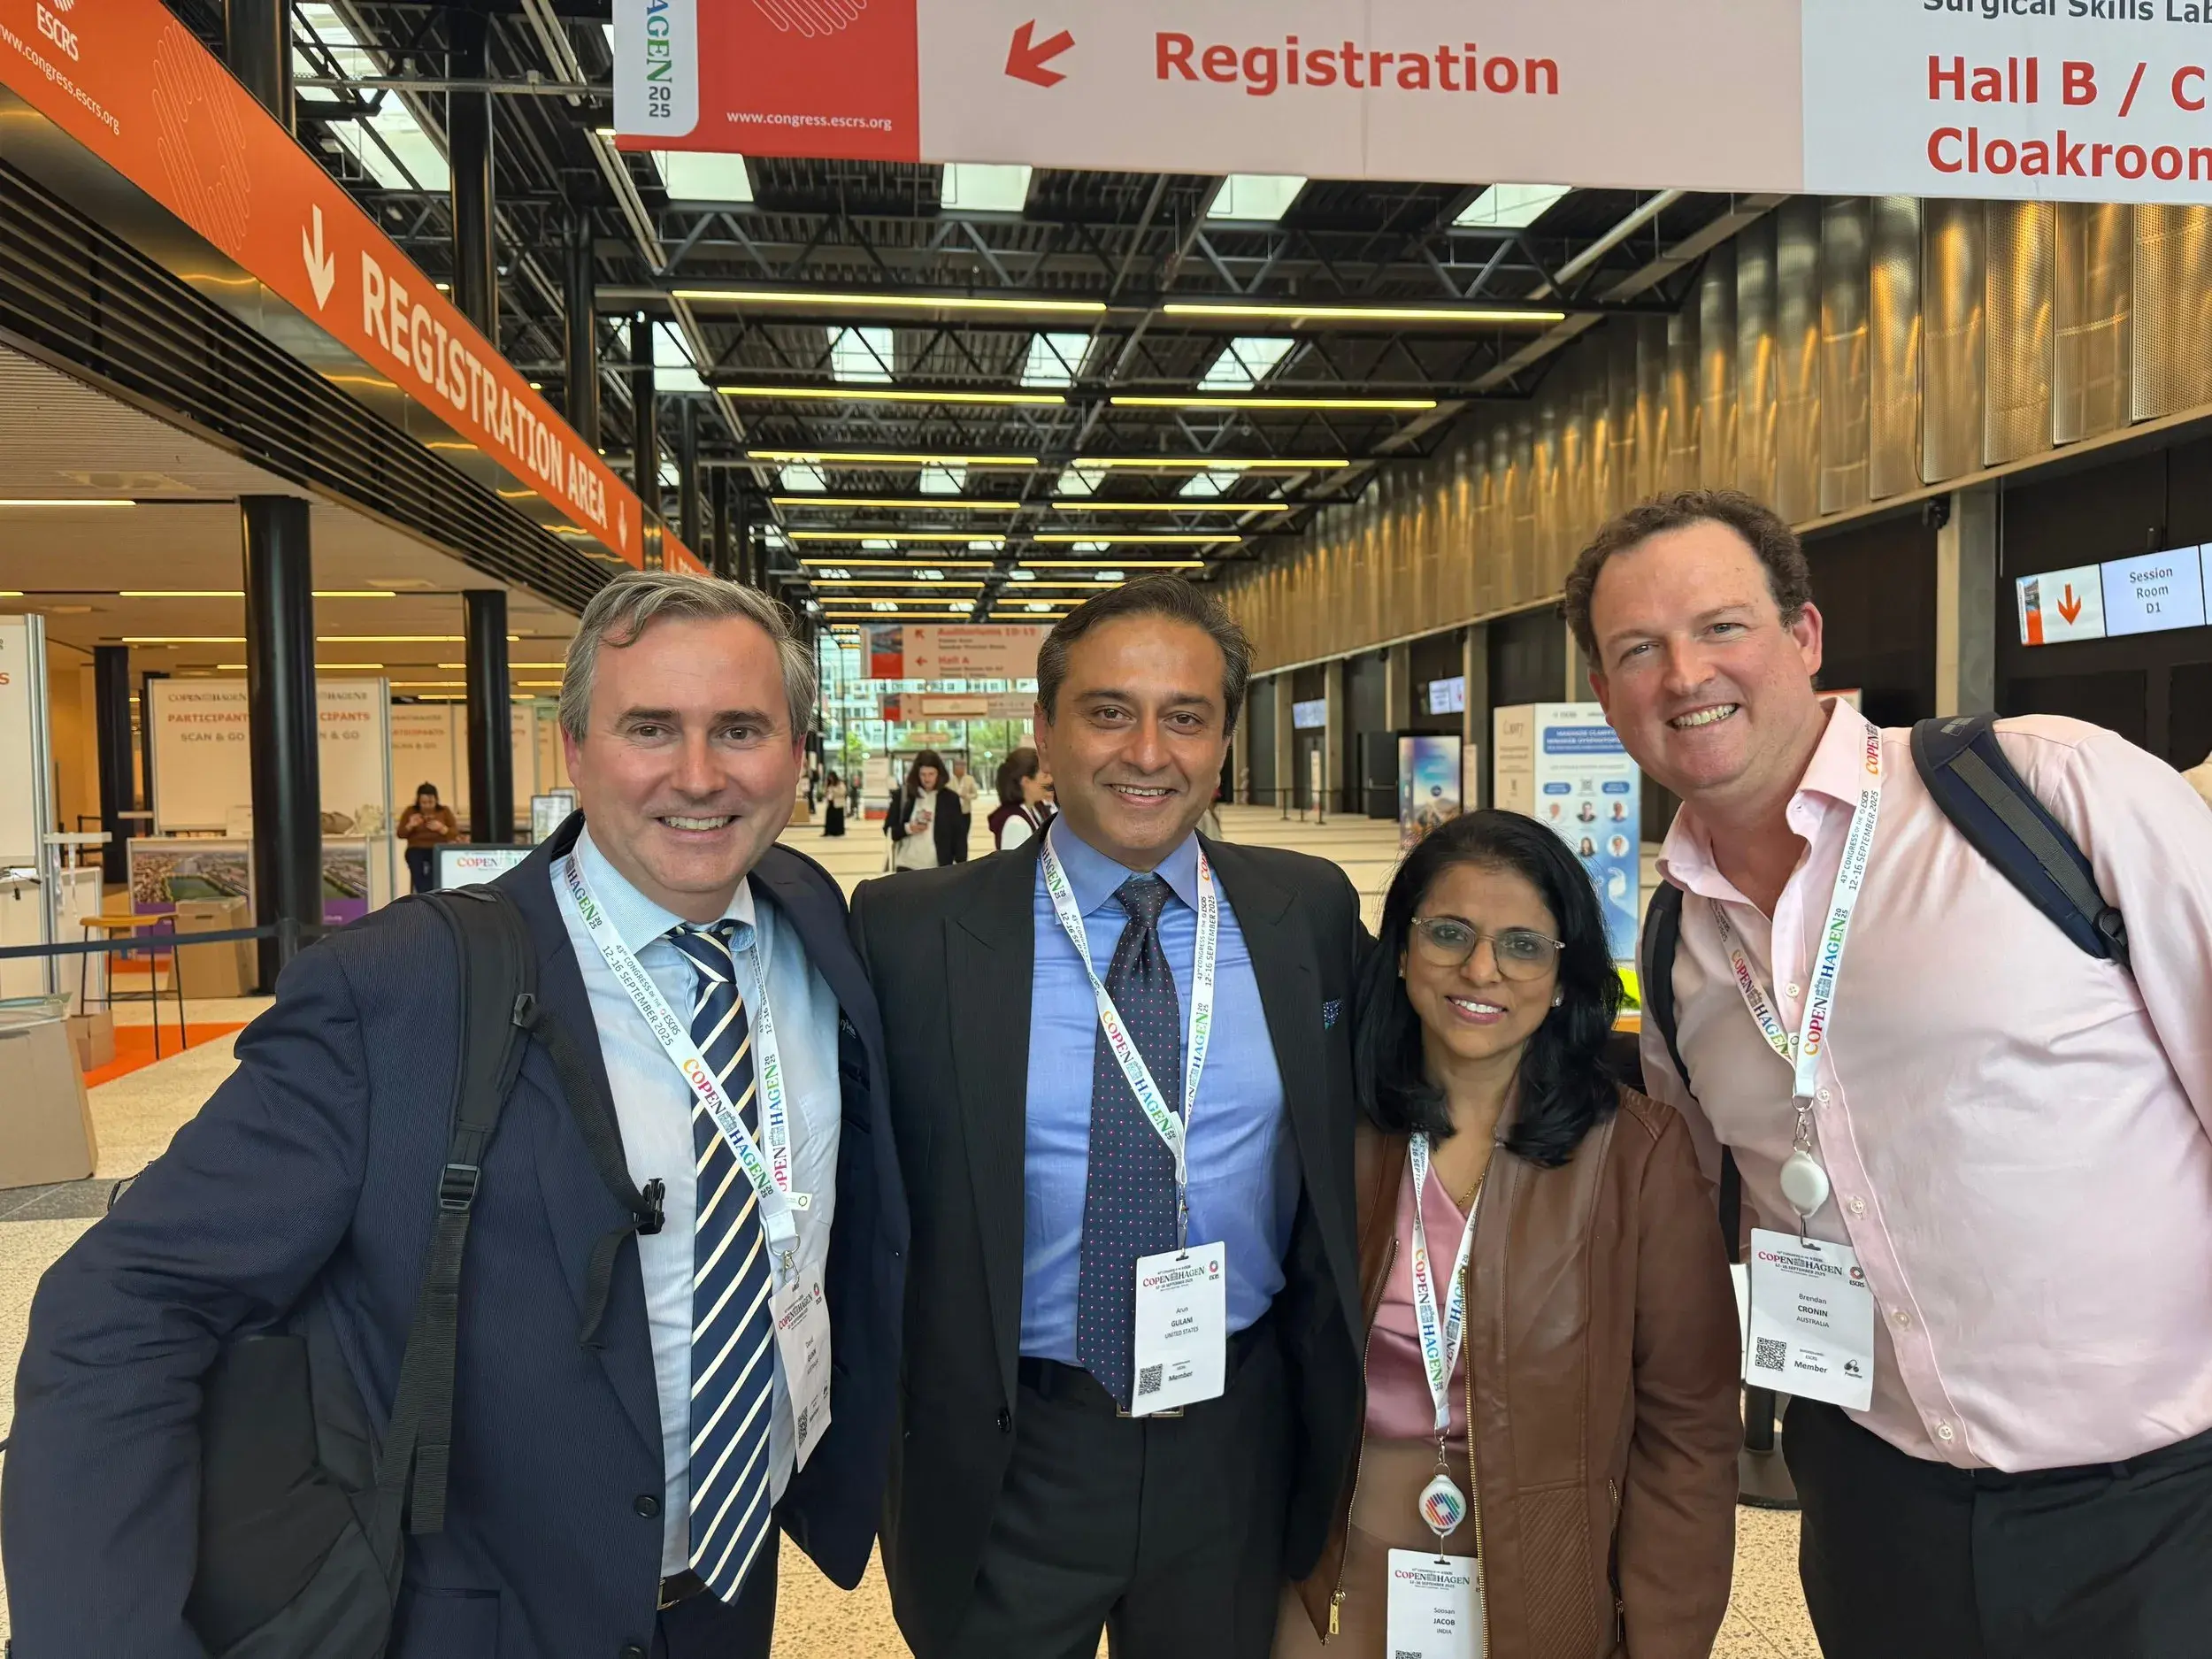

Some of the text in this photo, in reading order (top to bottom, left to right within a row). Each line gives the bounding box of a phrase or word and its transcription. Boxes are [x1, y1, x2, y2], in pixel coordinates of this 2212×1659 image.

[2068, 0, 2154, 20] Skills
[36, 2, 79, 62] ESCRS
[1156, 32, 1559, 96] Registration
[649, 86, 671, 101] 20
[1928, 55, 2205, 117] Hall B / C
[649, 104, 671, 118] 25
[726, 111, 892, 131] www.congress.escrs.org
[361, 250, 608, 531] REGISTRATION AREA
[2130, 566, 2173, 583] Session
[2136, 585, 2169, 599] Room
[2146, 603, 2162, 614] D1
[180, 733, 213, 741] SCAN
[227, 732, 245, 741] GO
[1865, 732, 1879, 779] COPEN
[1861, 812, 1876, 864] SEPTEMBER
[1870, 790, 1878, 812] 2025
[1845, 833, 1859, 870] CONGRESS
[566, 871, 598, 923] HAGEN
[595, 916, 603, 926] 20
[1834, 908, 1841, 917] 20
[1841, 909, 1848, 919] 25
[589, 920, 596, 930] 25
[1206, 914, 1217, 961] SEPTEMBER
[624, 956, 651, 992] CONGRESS
[663, 1014, 681, 1035] ESCRS
[1804, 918, 1847, 1056] COPENHAGEN
[619, 972, 658, 1024] SEPTEMBER
[654, 1022, 674, 1046] 2025
[1102, 1010, 1172, 1133] COPENHAGEN
[683, 1058, 771, 1189] COPENHAGEN
[1758, 1251, 1843, 1276] COPENHAGEN
[1143, 1266, 1205, 1287] COPENHAGEN
[1799, 1293, 1827, 1304] Brendan
[1415, 1248, 1443, 1382] COPENHAGEN
[1797, 1305, 1828, 1317] CRONIN
[1171, 1317, 1194, 1327] GULANI
[1796, 1316, 1830, 1327] AUSTRALIA
[1164, 1326, 1199, 1339] UNITED STATES
[1168, 1371, 1193, 1381] Member
[1794, 1361, 1828, 1373] Member
[1394, 1570, 1470, 1585] COPENHAGEN
